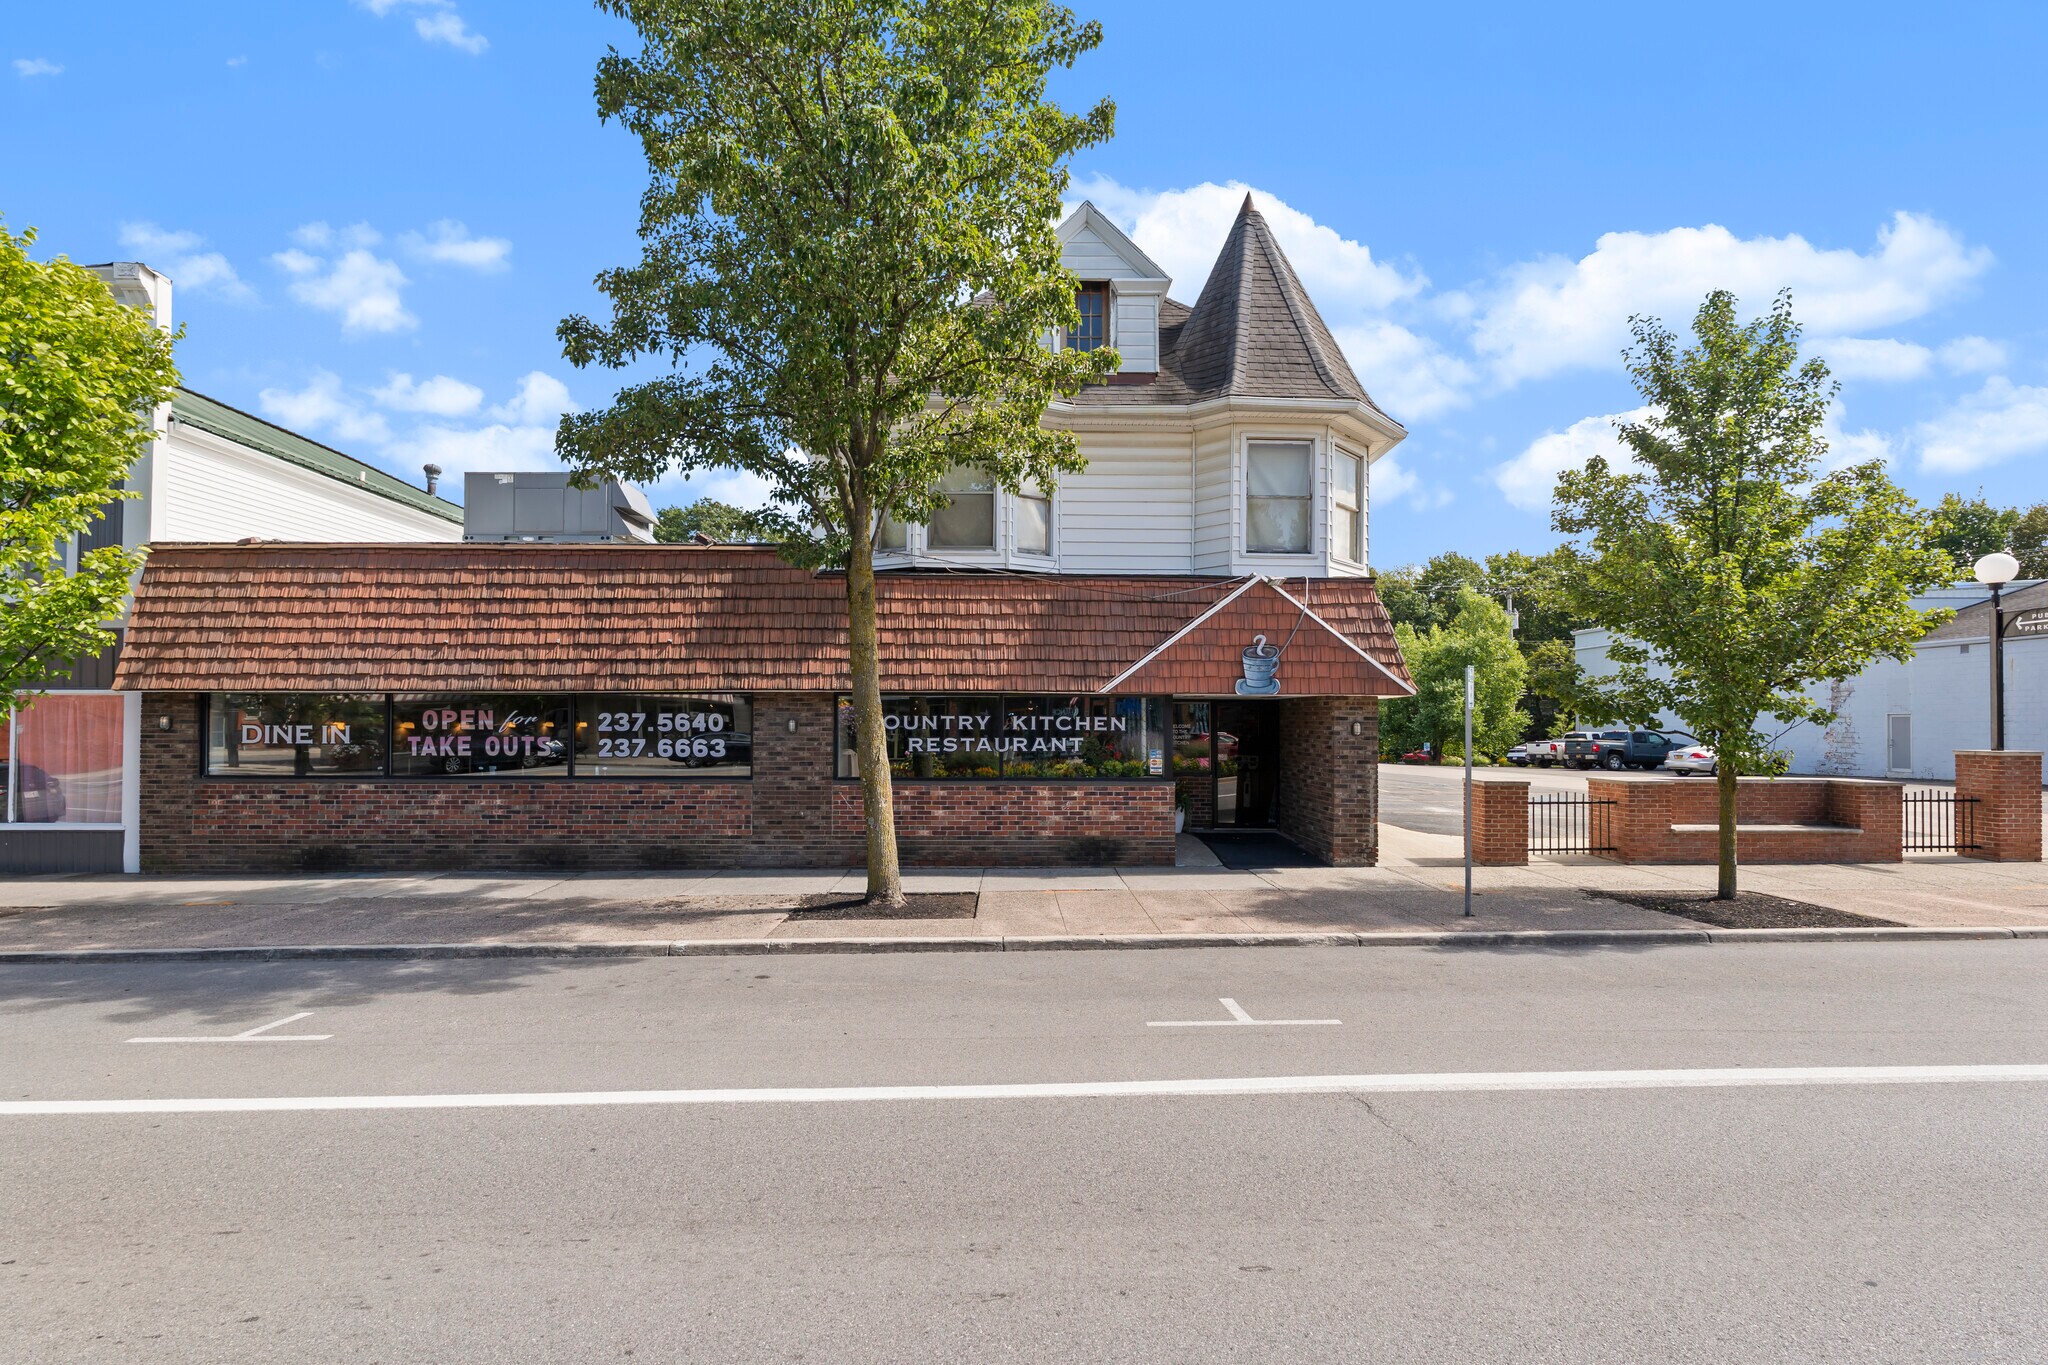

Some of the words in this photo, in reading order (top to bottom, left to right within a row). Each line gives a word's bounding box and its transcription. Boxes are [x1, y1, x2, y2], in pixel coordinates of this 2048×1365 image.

[422, 709, 494, 731] OPEN
[498, 709, 538, 734] for
[597, 712, 724, 732] 237.5640
[883, 714, 991, 730] OUNTRY
[1012, 715, 1126, 731] KITCHEN
[241, 724, 314, 745] DINE
[321, 724, 351, 745] IN
[908, 737, 1084, 752] RESTAURANT
[407, 735, 472, 757] TAKE
[484, 735, 552, 757] OUTS
[598, 738, 727, 758] 237.6663
